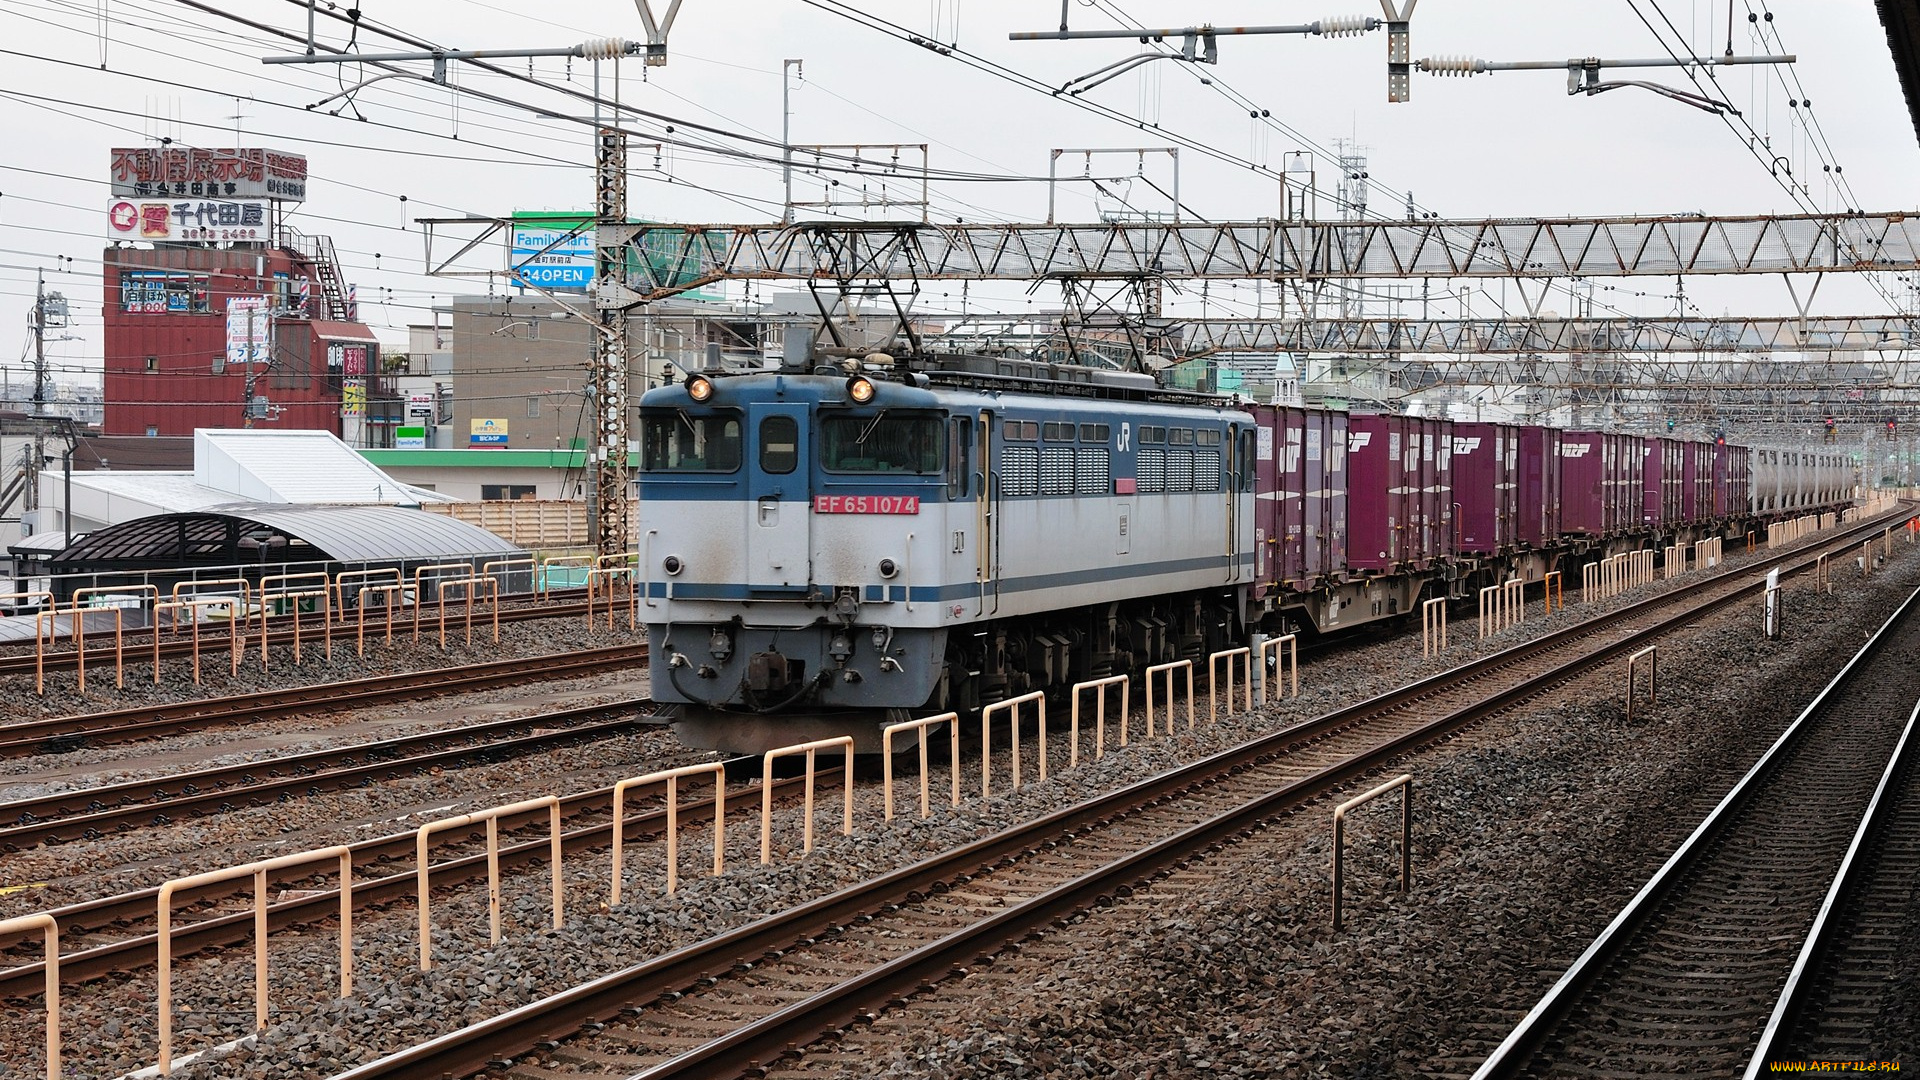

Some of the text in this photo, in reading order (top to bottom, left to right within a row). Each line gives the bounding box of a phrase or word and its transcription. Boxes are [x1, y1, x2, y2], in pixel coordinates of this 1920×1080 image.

[111, 149, 264, 182] 不動産展示場
[171, 202, 263, 226] 千代田屋
[1117, 422, 1130, 452] JR
[818, 496, 916, 513] EF 65 1074
